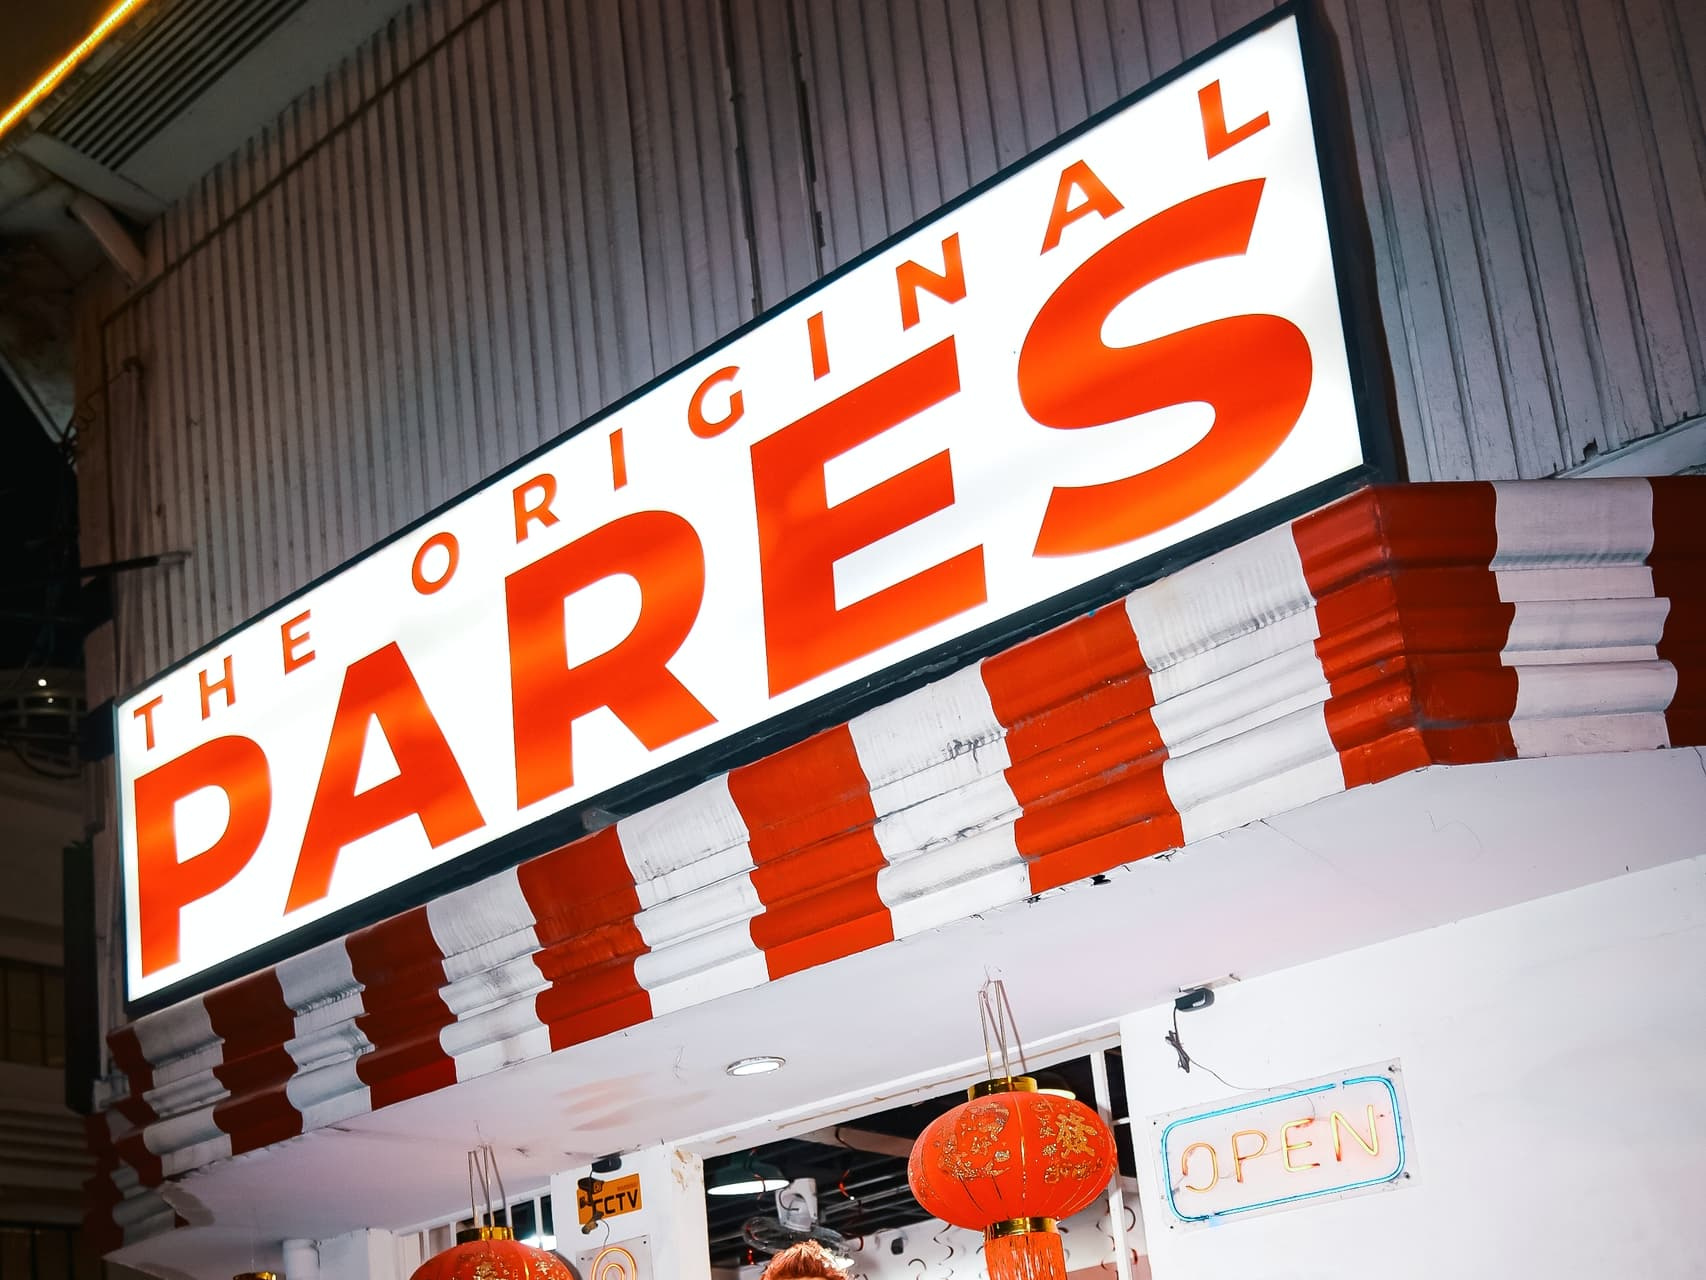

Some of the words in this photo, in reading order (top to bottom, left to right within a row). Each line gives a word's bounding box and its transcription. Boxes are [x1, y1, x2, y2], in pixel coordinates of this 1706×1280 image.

[133, 177, 1313, 978] PARES
[134, 609, 316, 750] THE
[411, 79, 1271, 595] ORIGINAL
[1181, 1104, 1379, 1194] OPEN
